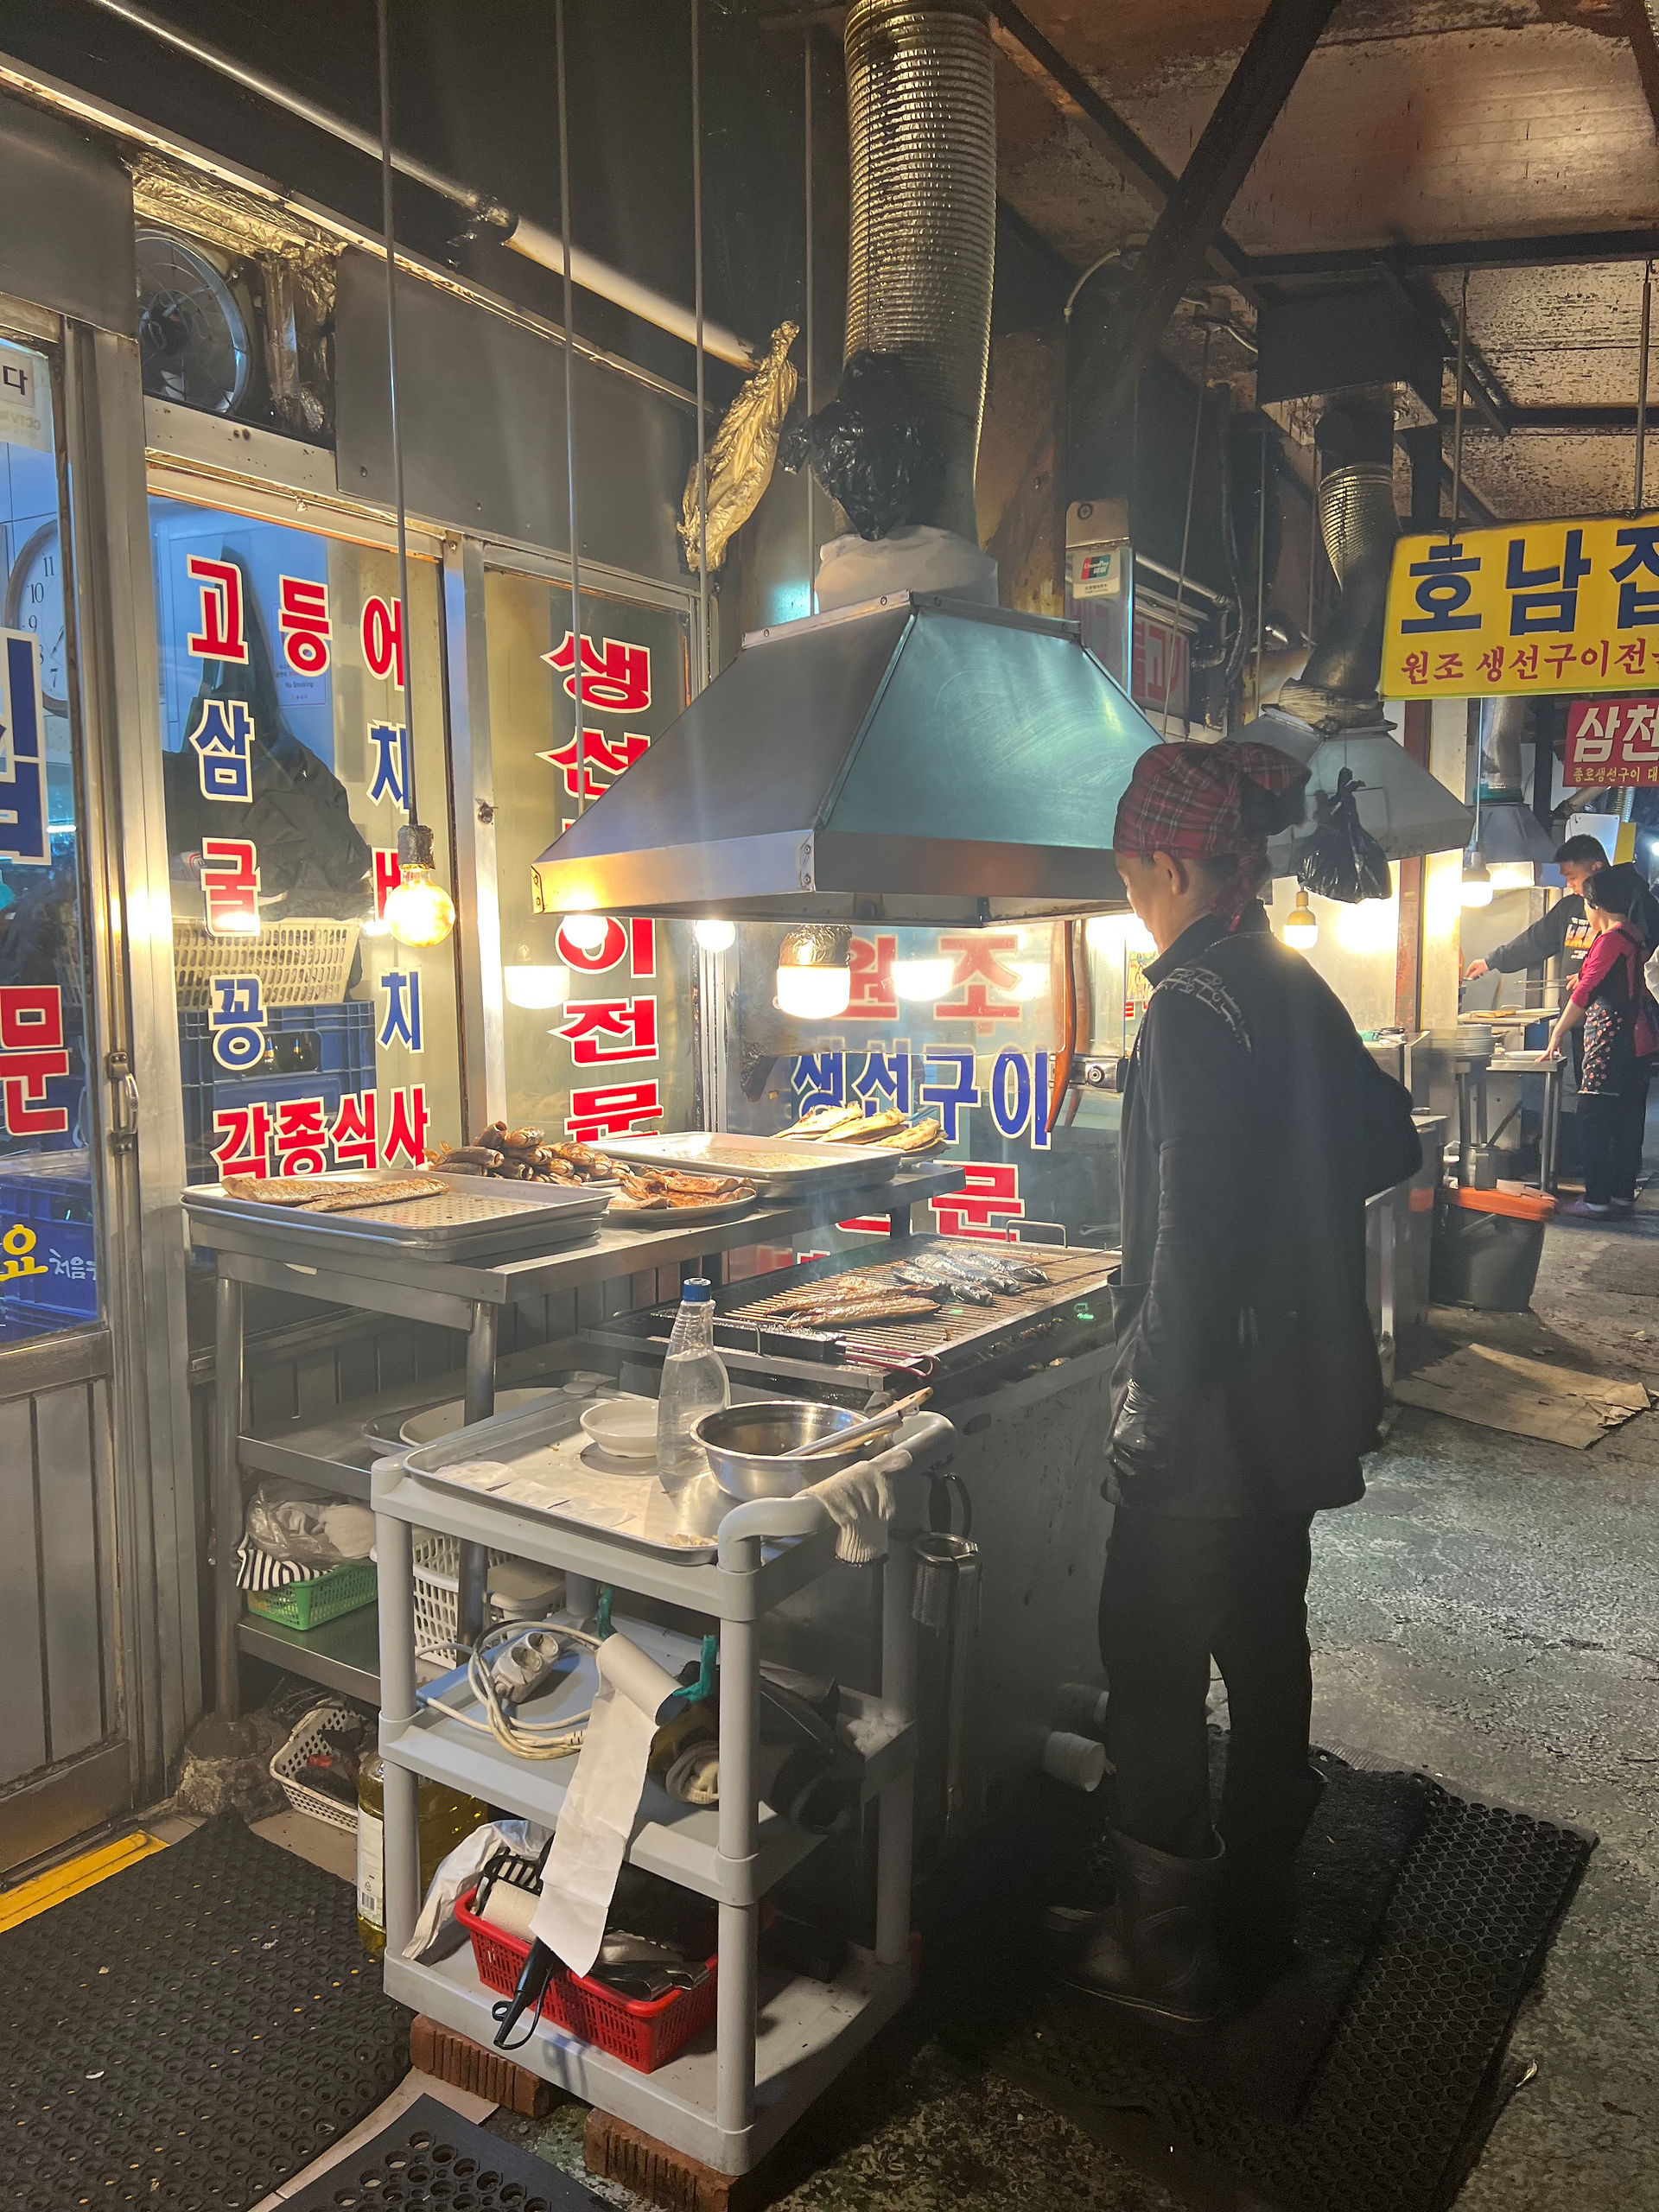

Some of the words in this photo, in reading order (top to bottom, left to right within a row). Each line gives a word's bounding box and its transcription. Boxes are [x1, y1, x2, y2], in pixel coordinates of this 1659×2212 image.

[3, 365, 29, 396] 다
[43, 556, 54, 577] 11
[30, 582, 44, 603] 10
[29, 614, 38, 633] 9
[1401, 650, 1464, 685] 원조
[1476, 638, 1659, 683] 생선구이전
[50, 667, 59, 688] 7
[1573, 766, 1641, 783] 종로생선구이
[791, 1037, 1052, 1150] 생선구이
[210, 1084, 431, 1180] 각종식사
